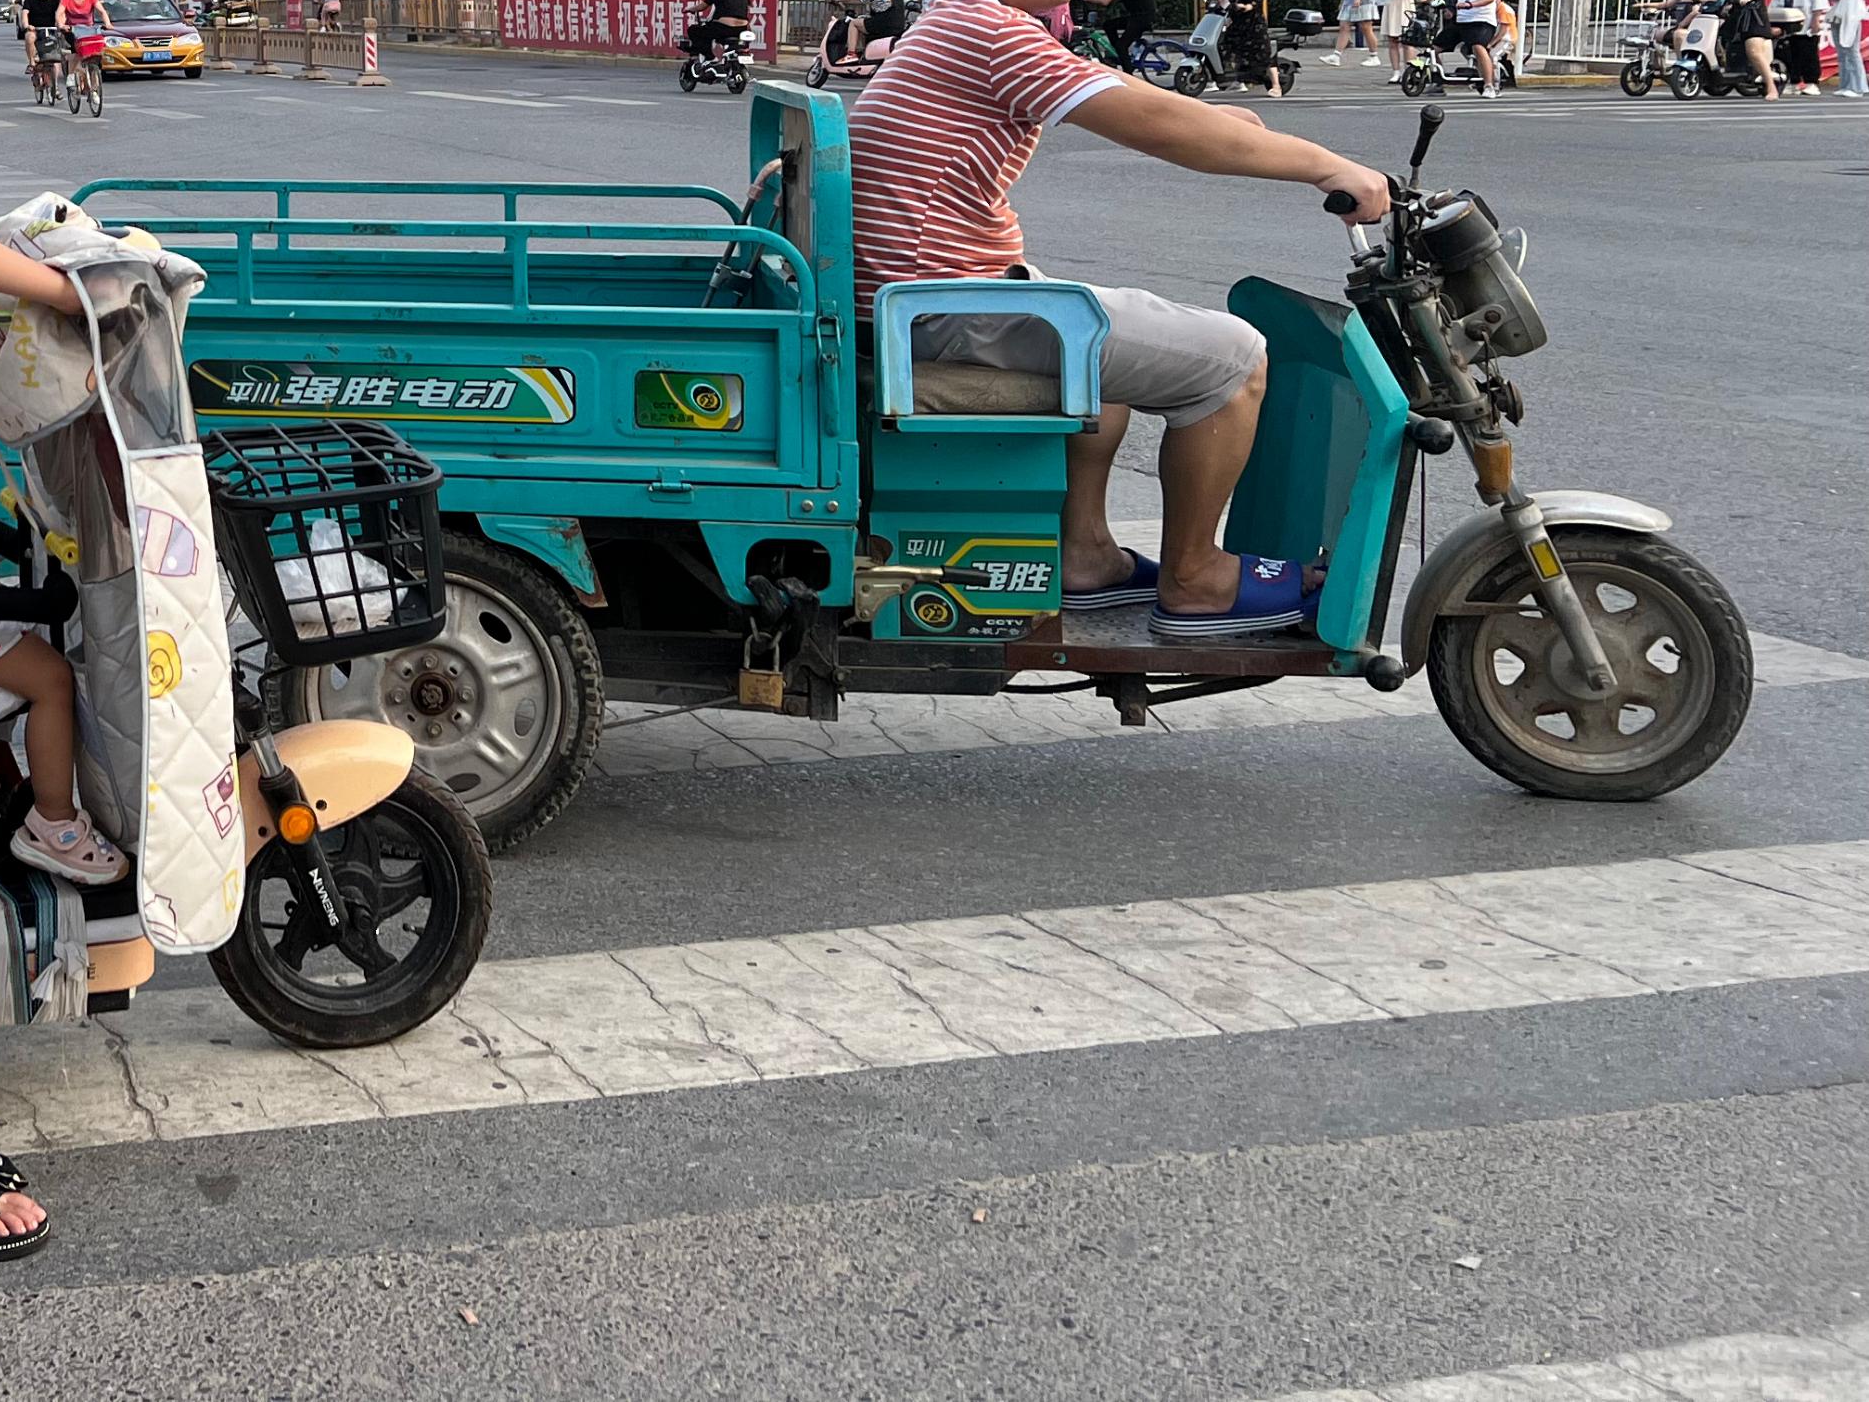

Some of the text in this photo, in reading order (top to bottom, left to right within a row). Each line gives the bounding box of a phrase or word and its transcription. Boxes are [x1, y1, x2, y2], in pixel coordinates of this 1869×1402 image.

[281, 376, 516, 409] 强胜电动
[906, 539, 945, 557] 平川
[964, 562, 1052, 592] 强胜
